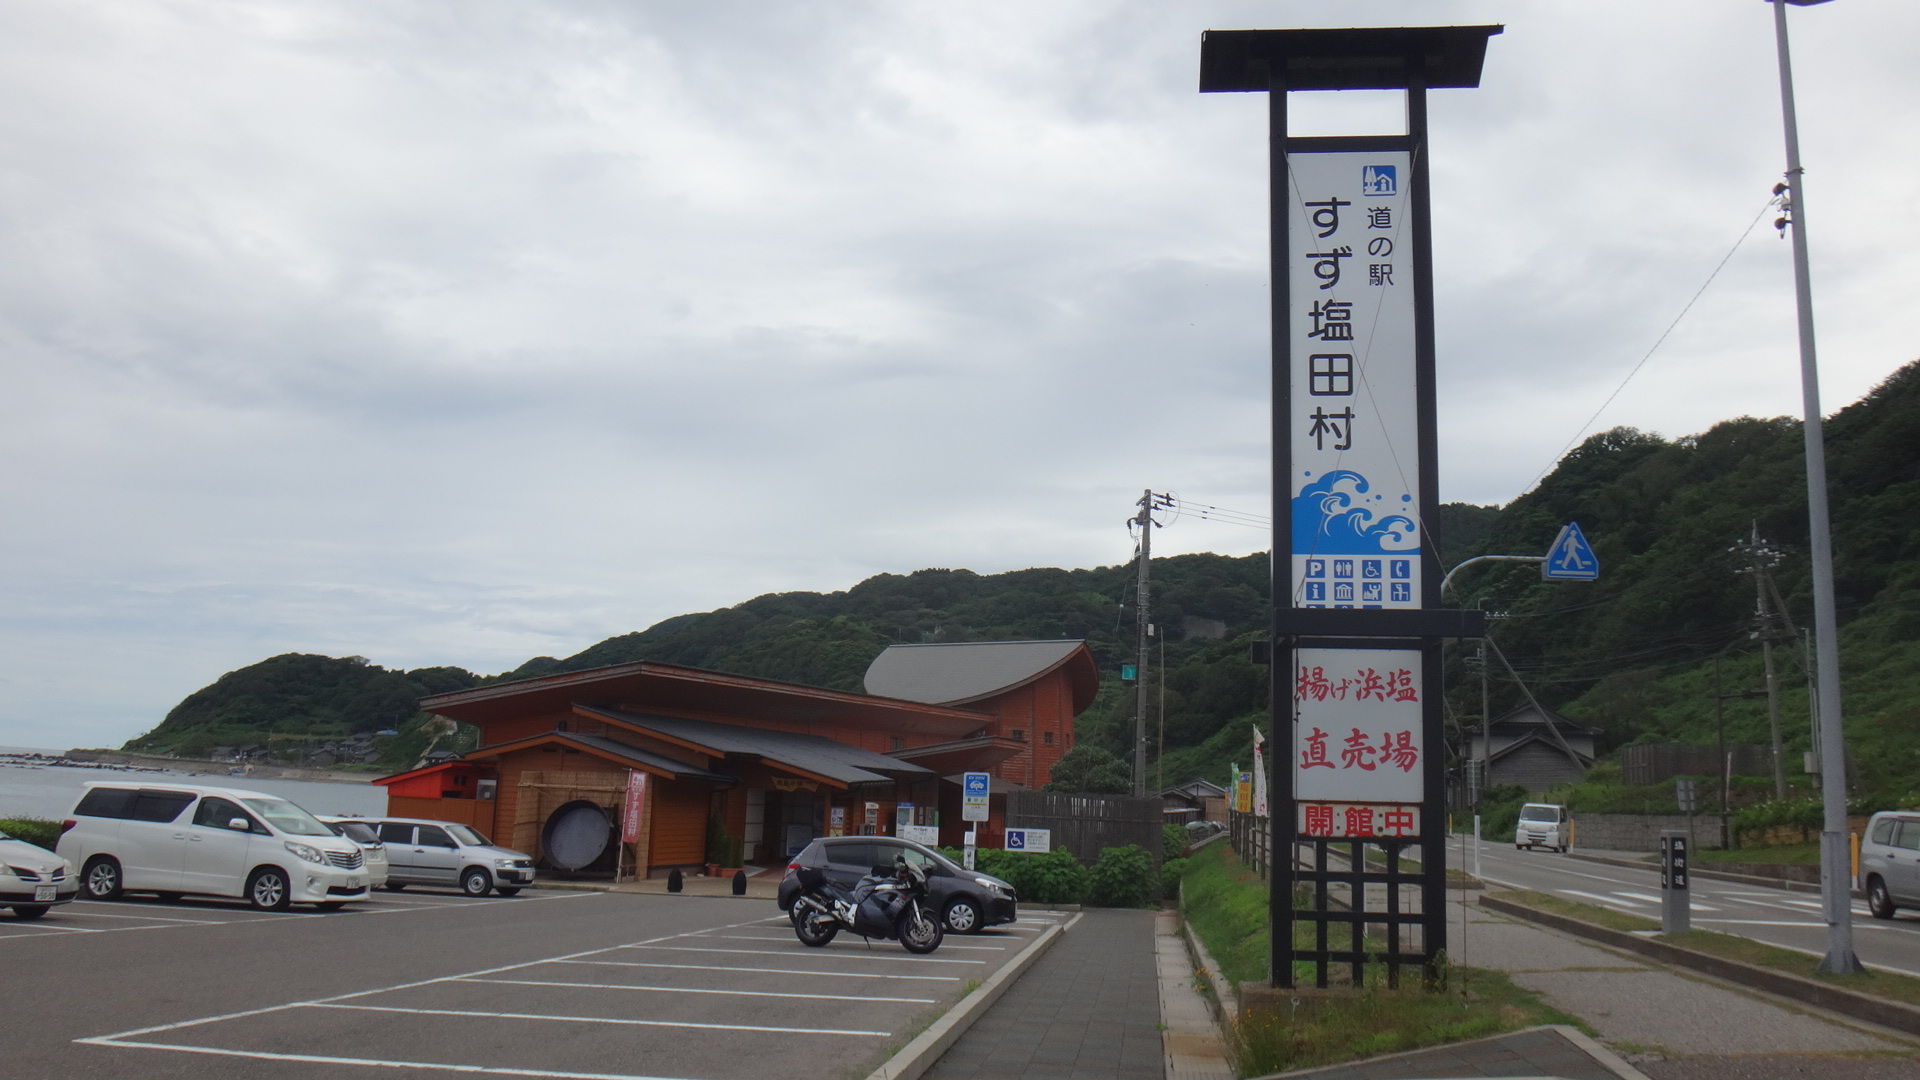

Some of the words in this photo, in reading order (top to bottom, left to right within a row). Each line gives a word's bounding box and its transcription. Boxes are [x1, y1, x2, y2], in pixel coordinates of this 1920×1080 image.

[1367, 206, 1394, 286] 道の駅
[1304, 196, 1356, 451] すず塩田村
[1298, 665, 1419, 703] 揚げ浜塩
[1300, 726, 1419, 773] 直売場
[1304, 805, 1414, 838] 開館中
